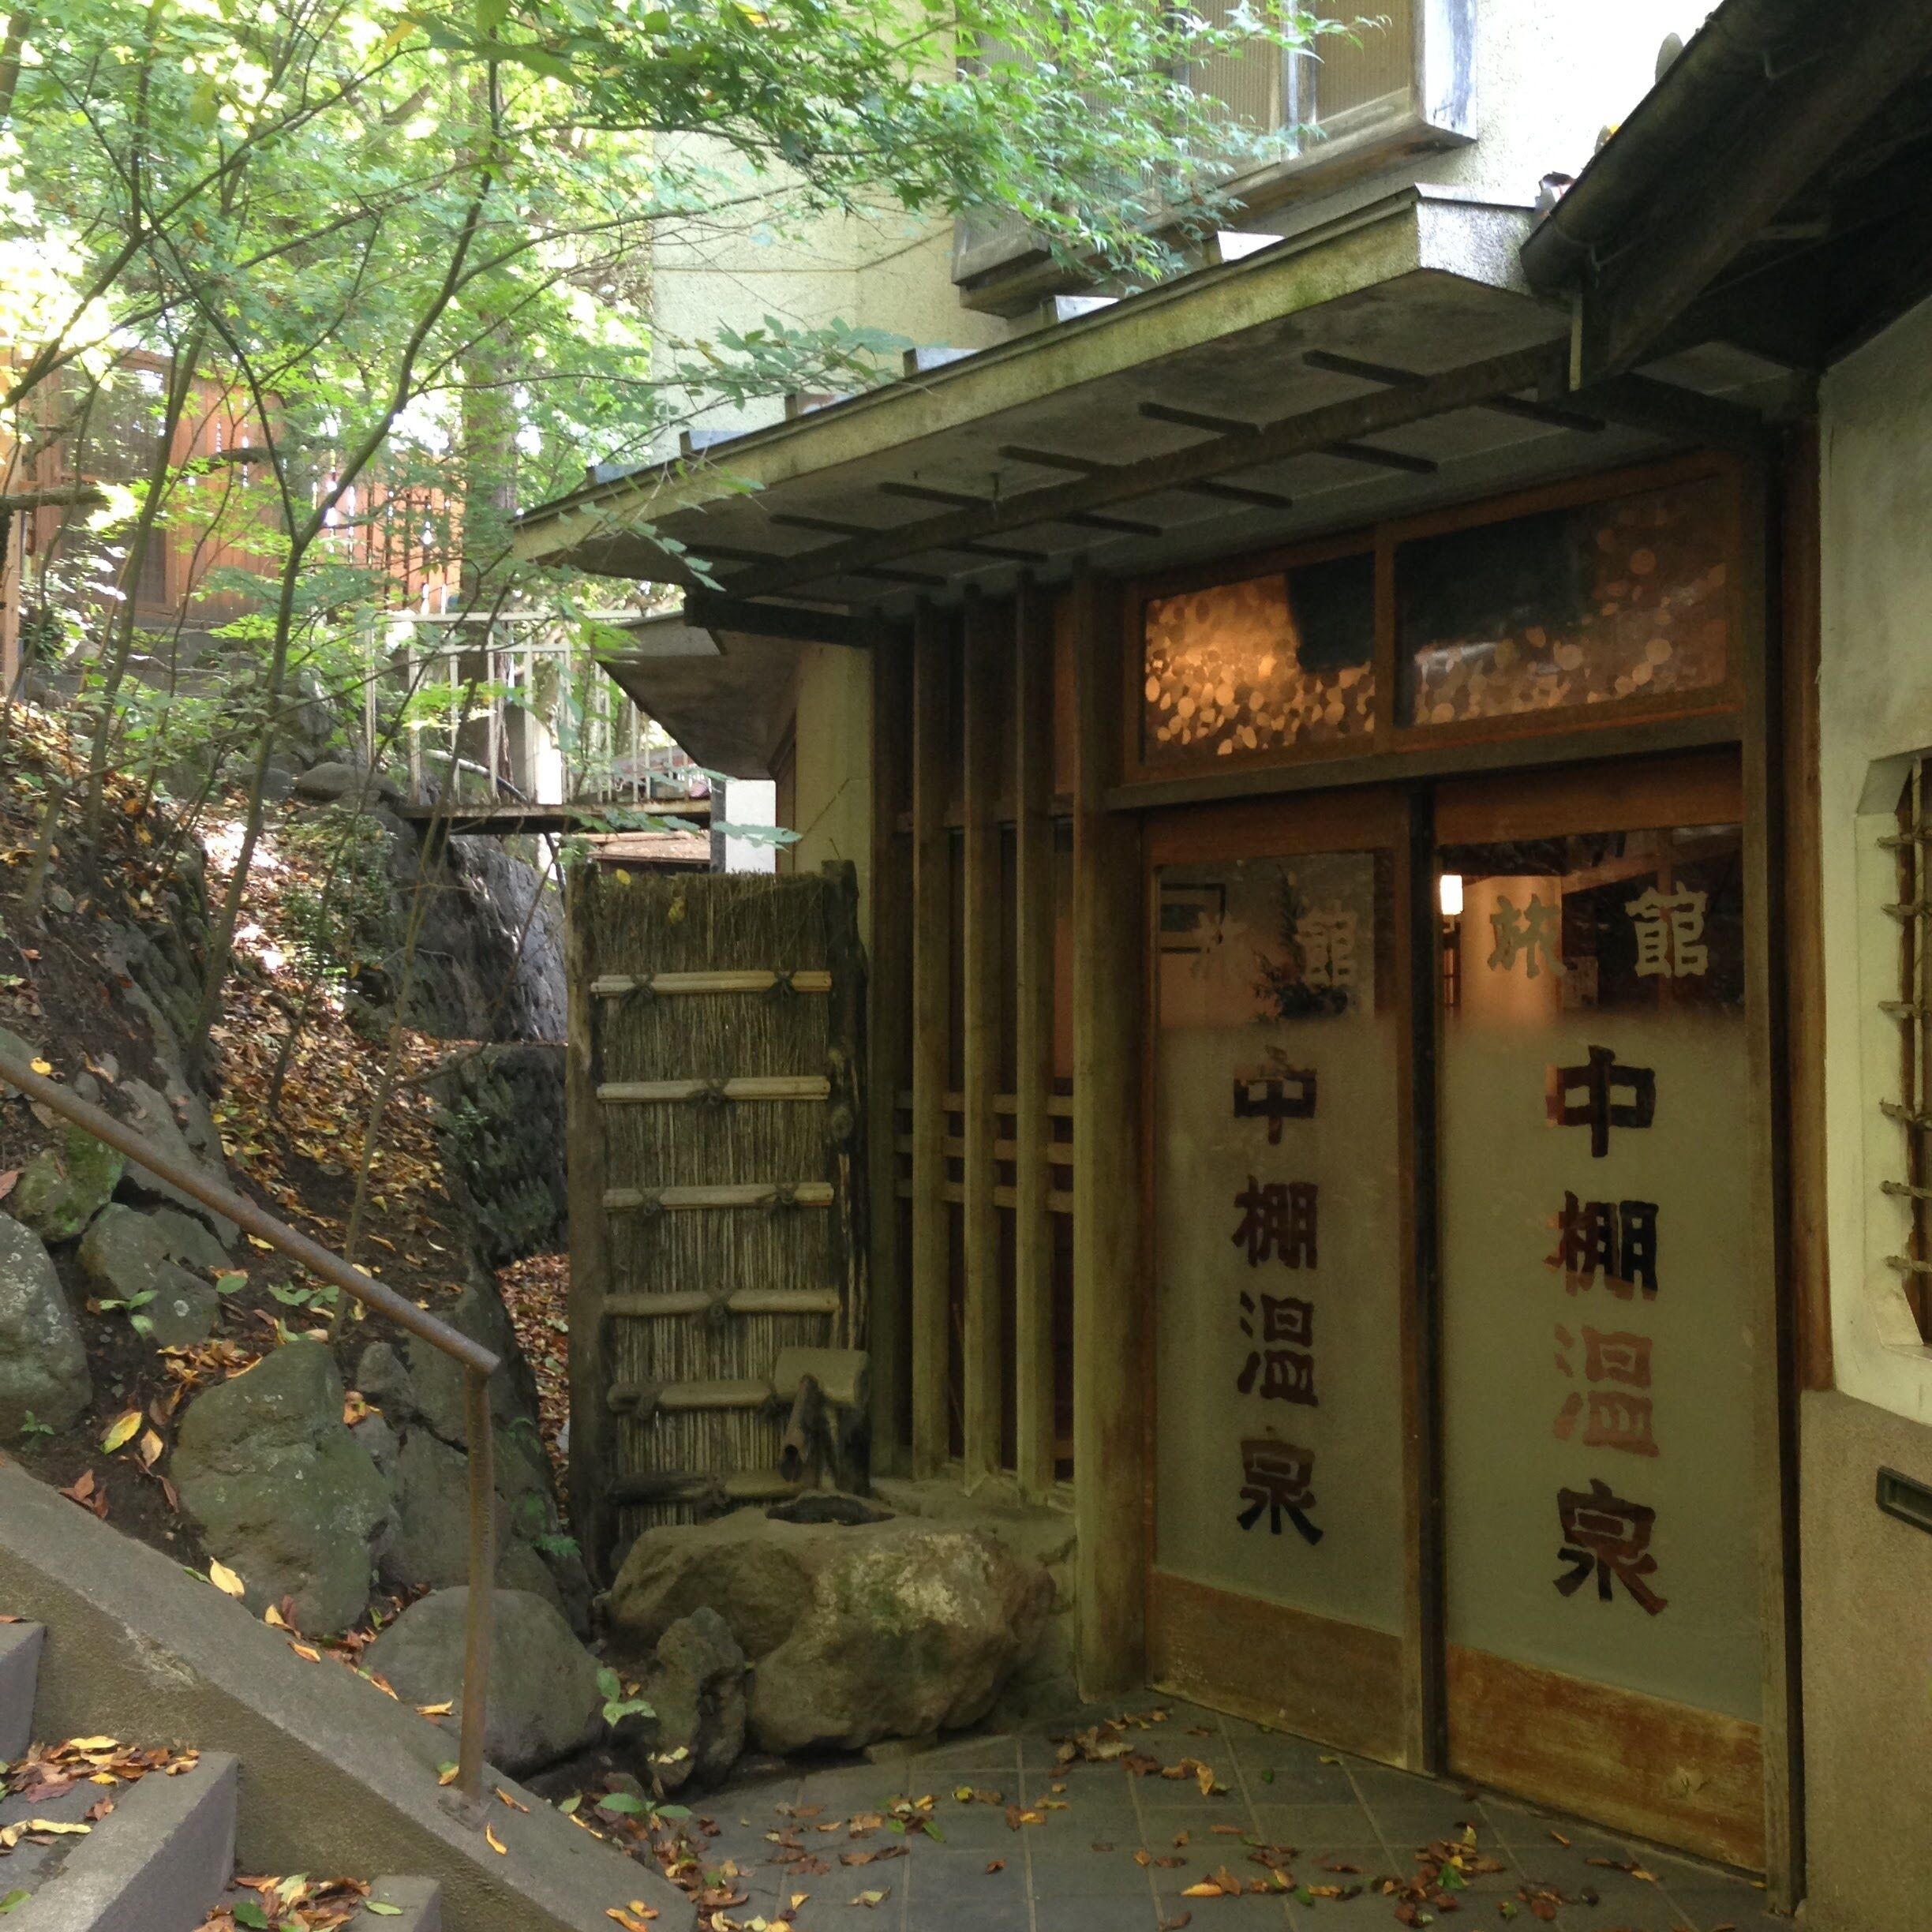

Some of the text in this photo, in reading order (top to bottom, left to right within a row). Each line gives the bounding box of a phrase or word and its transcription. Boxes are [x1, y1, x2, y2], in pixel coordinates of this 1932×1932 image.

[1487, 881, 1709, 979] 旅館
[1232, 1046, 1323, 1544] 中棚温泉
[1545, 1044, 1668, 1616] 中棚温泉
